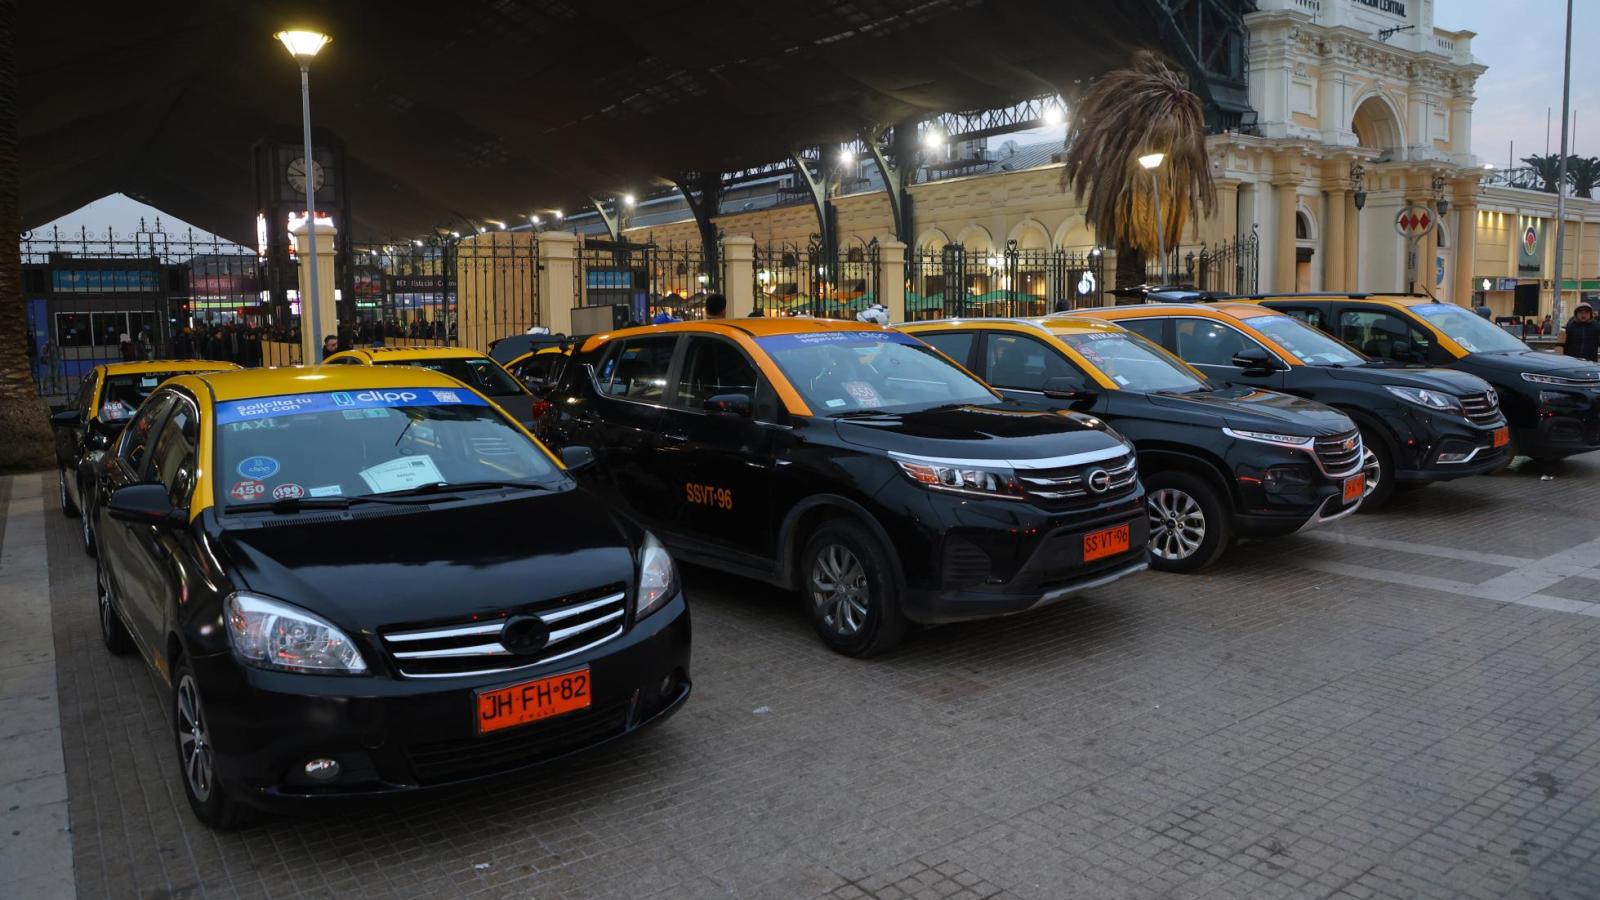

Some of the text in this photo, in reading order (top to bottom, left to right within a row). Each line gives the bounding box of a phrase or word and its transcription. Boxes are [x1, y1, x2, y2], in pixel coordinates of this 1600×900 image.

[357, 390, 417, 403] clipp
[236, 400, 293, 411] Solicita
[240, 404, 301, 417] taxi con
